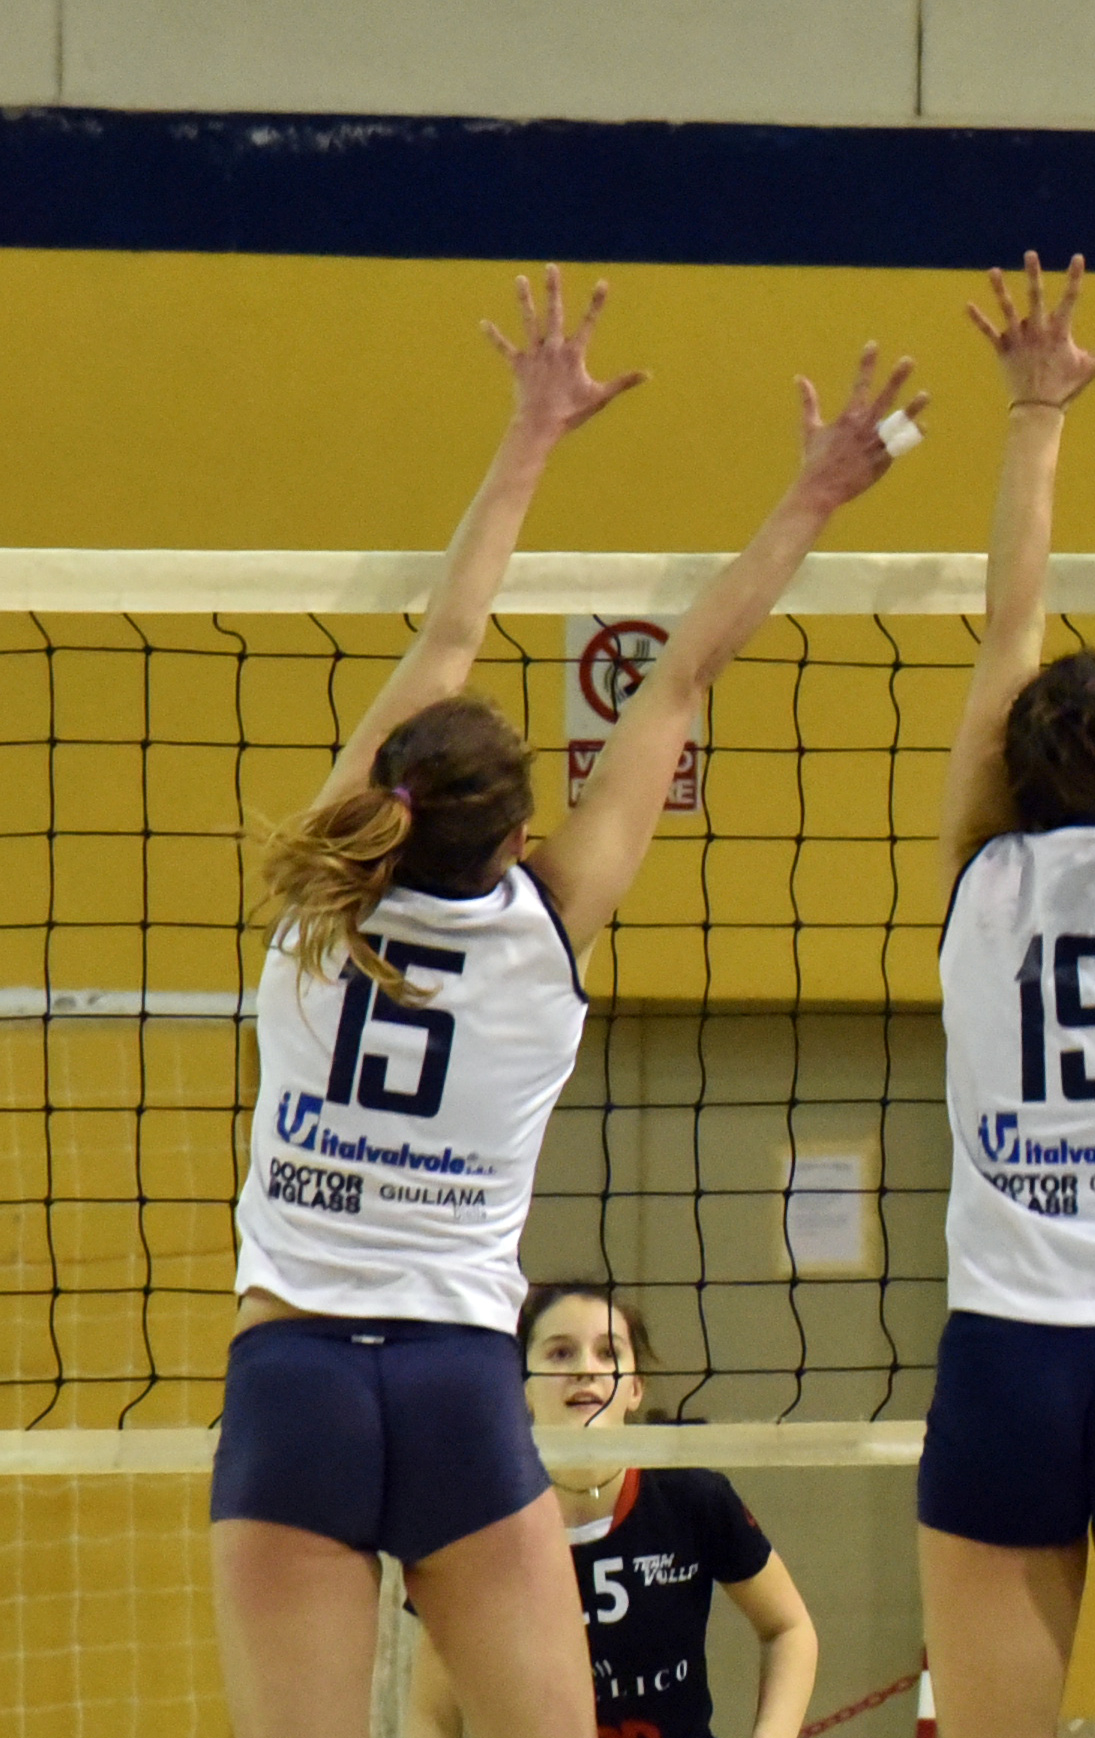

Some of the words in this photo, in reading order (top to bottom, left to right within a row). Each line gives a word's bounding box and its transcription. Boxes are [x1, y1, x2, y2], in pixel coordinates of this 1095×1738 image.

[326, 933, 466, 1118] 15
[320, 1128, 466, 1175] italvalvole
[270, 1156, 364, 1194] DOCTOR
[379, 1184, 487, 1206] GIULIANA
[633, 1552, 675, 1574] TEAM
[583, 1556, 629, 1623] 5
[609, 1659, 688, 1698] LICO
